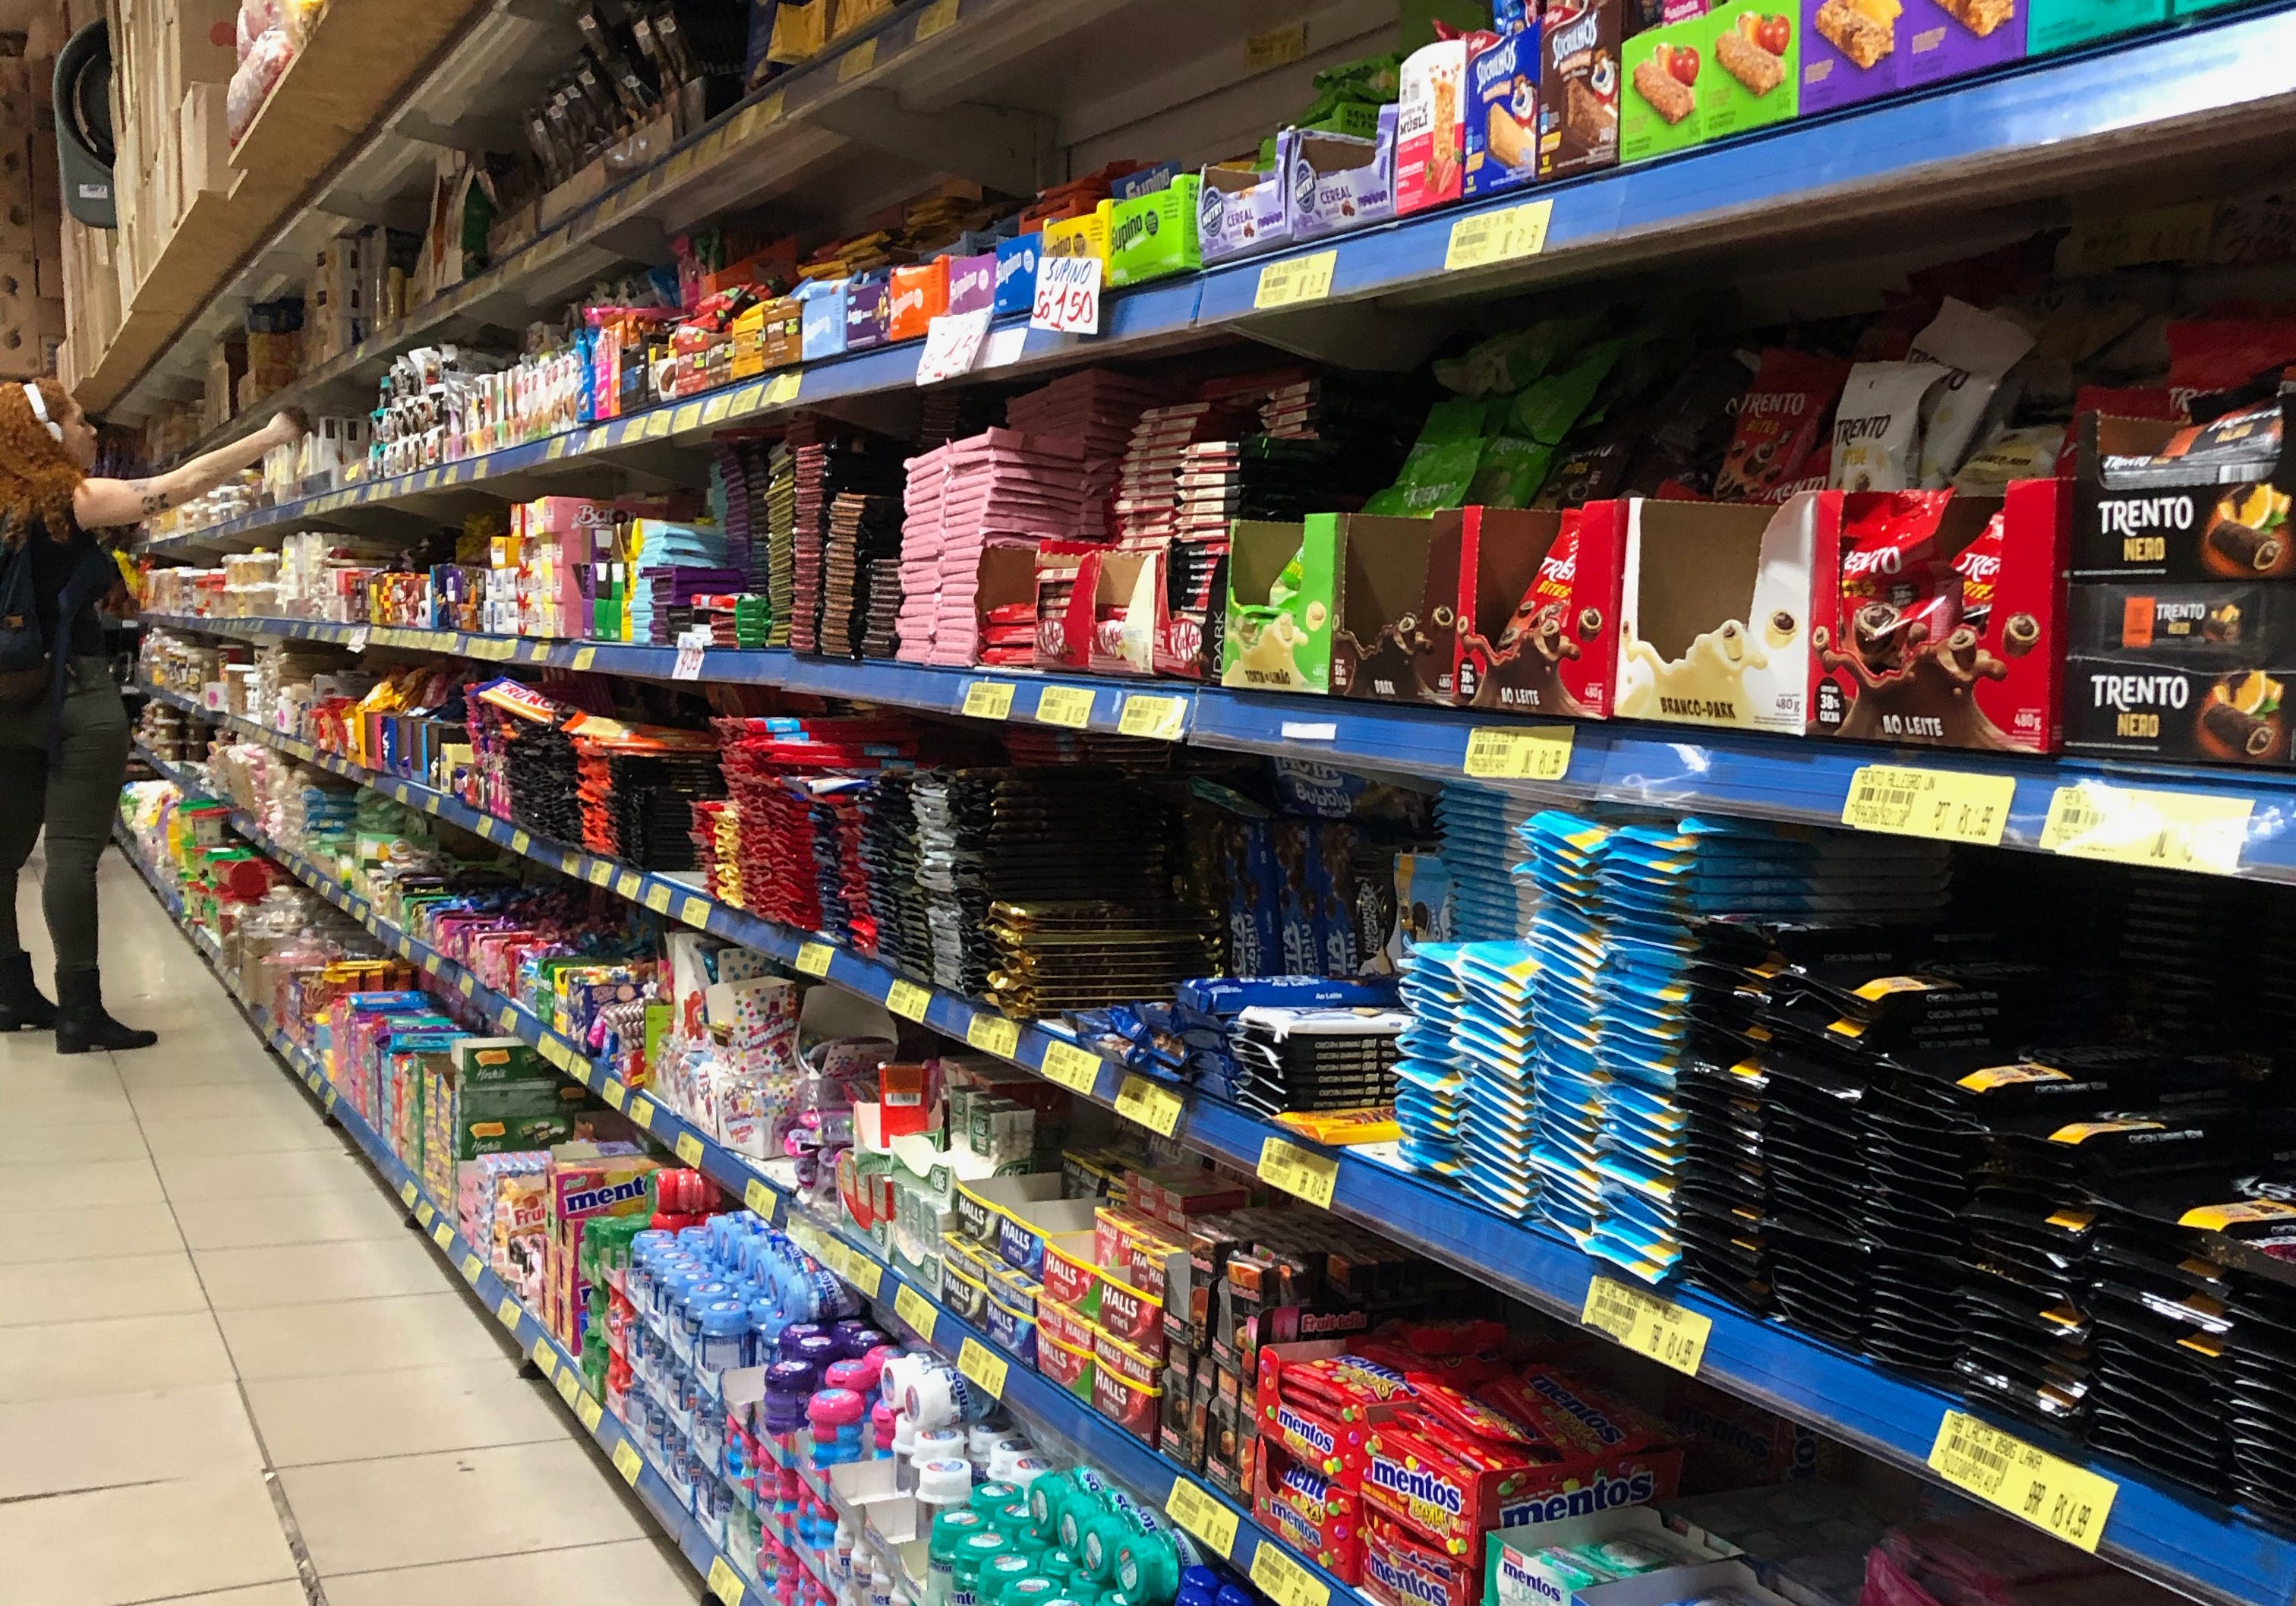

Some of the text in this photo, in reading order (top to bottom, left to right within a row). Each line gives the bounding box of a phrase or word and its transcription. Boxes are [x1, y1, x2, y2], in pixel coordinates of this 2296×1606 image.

[1320, 185, 1352, 205] CEREAL
[1226, 208, 1254, 228] CEREAL
[1045, 258, 1093, 286] SUPINO
[1739, 392, 1807, 418] TRENTO
[1834, 414, 1891, 446] TRENTO
[2097, 495, 2194, 536] TRENTO
[2123, 536, 2166, 562] NERO
[2156, 603, 2206, 622] TRENTO
[1213, 611, 1225, 673] DARK
[1515, 688, 1541, 705] LEITE
[1660, 696, 1736, 719] BRANCO-DARK
[2090, 674, 2190, 712] TRENTO
[1904, 716, 1944, 737] LEITE
[2116, 713, 2160, 738] NERO
[1295, 781, 1352, 814] Bubbly
[959, 1197, 985, 1226] HALLS
[1001, 1219, 1030, 1250] HALLS
[1096, 1218, 1118, 1242] HALLS
[1046, 1251, 1077, 1286] HALLS
[1149, 1268, 1164, 1289] HAL
[945, 1271, 970, 1302] HALLS
[1102, 1284, 1137, 1319] HALLS
[987, 1302, 1013, 1333] HALLS
[1065, 1320, 1092, 1346] HALLS
[1039, 1336, 1068, 1368] HALLS
[1096, 1339, 1151, 1383] HALLS HALLS
[1095, 1370, 1127, 1406] HALLS
[1528, 1373, 1627, 1444] mentos
[1278, 1407, 1333, 1453] mentos
[1374, 1459, 1462, 1513] mentos
[1500, 1472, 1654, 1529] mentos
[1270, 1498, 1322, 1550] mentos
[1370, 1552, 1448, 1606] mentos
[1503, 1562, 1561, 1603] mentos
